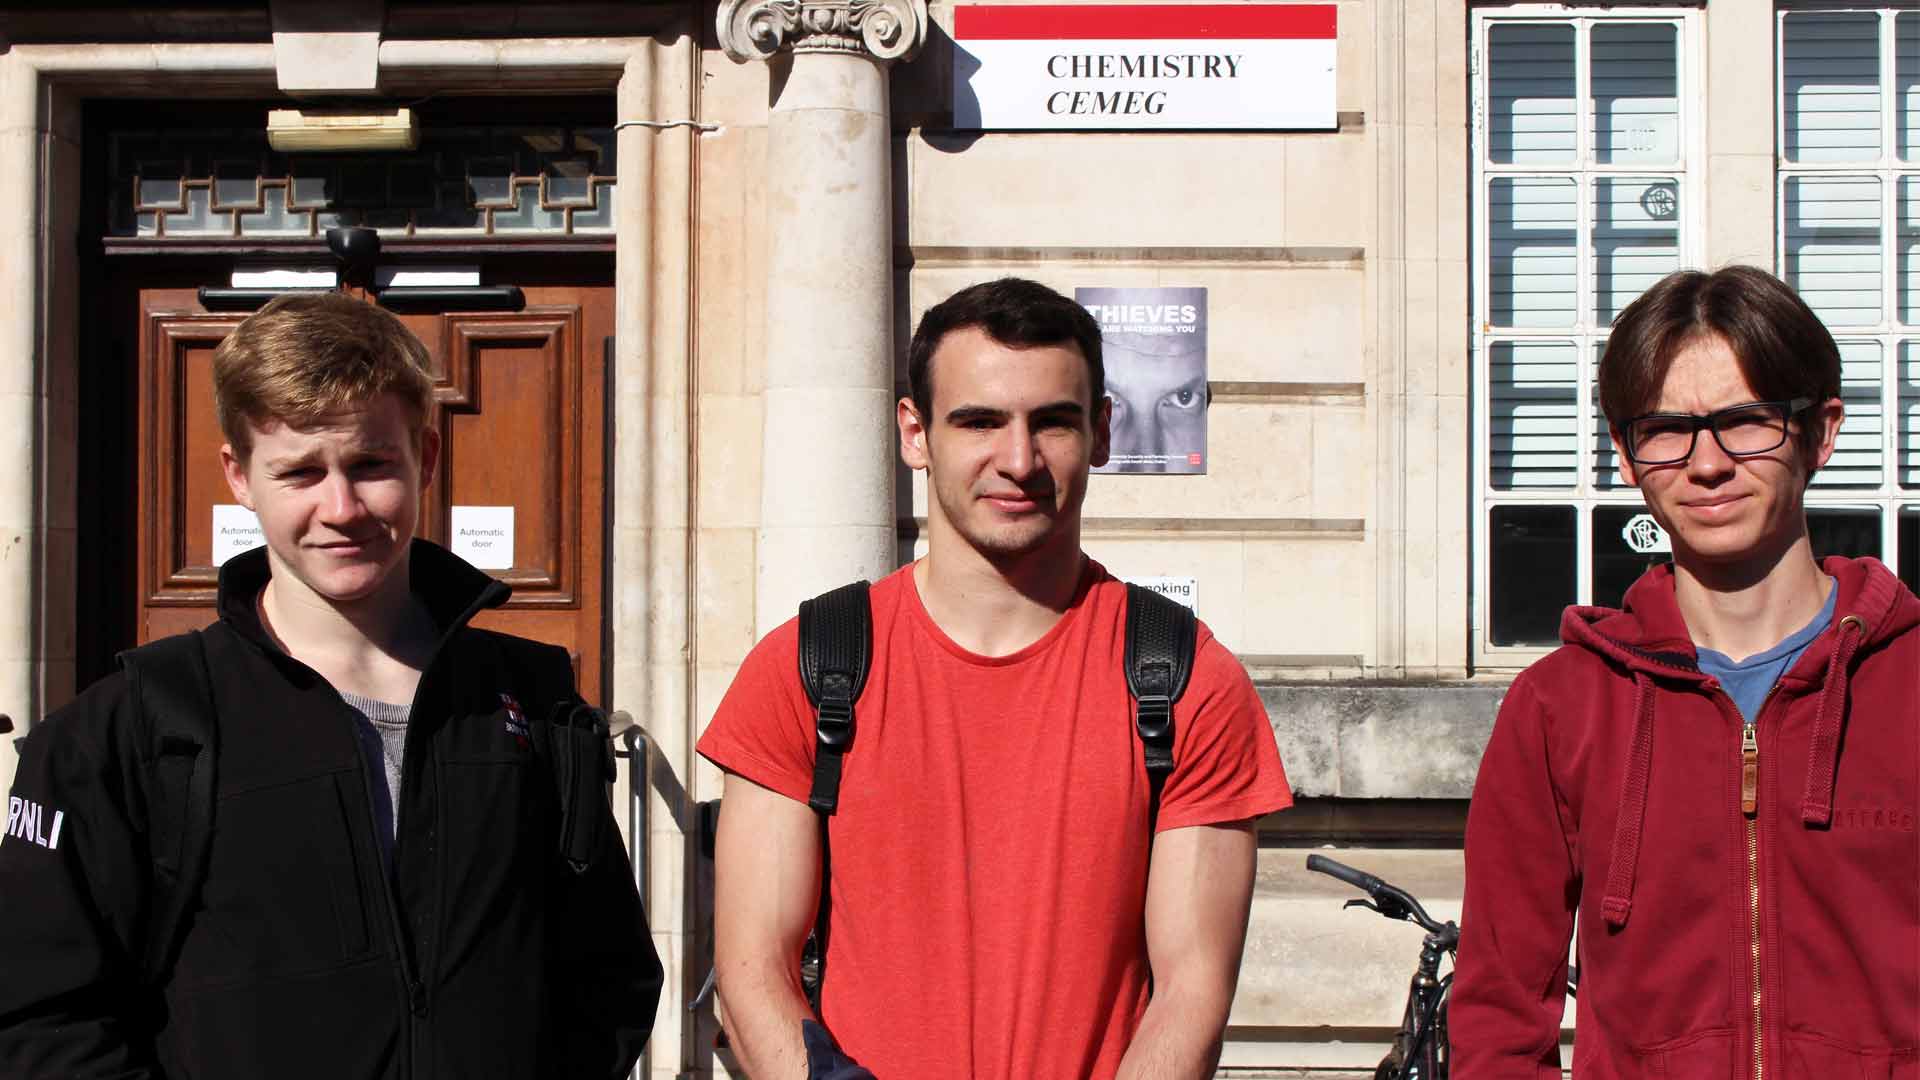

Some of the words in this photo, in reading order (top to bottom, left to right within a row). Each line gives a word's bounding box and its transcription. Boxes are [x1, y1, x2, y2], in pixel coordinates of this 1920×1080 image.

[1047, 55, 1242, 79] CHEMISTRY
[1047, 91, 1167, 115] CEMEG
[1084, 305, 1197, 323] THIEVES
[1175, 325, 1196, 333] YOU
[220, 527, 262, 536] Automati
[459, 527, 505, 537] Automatic
[471, 539, 493, 548] door
[8, 796, 64, 850] RNLI
